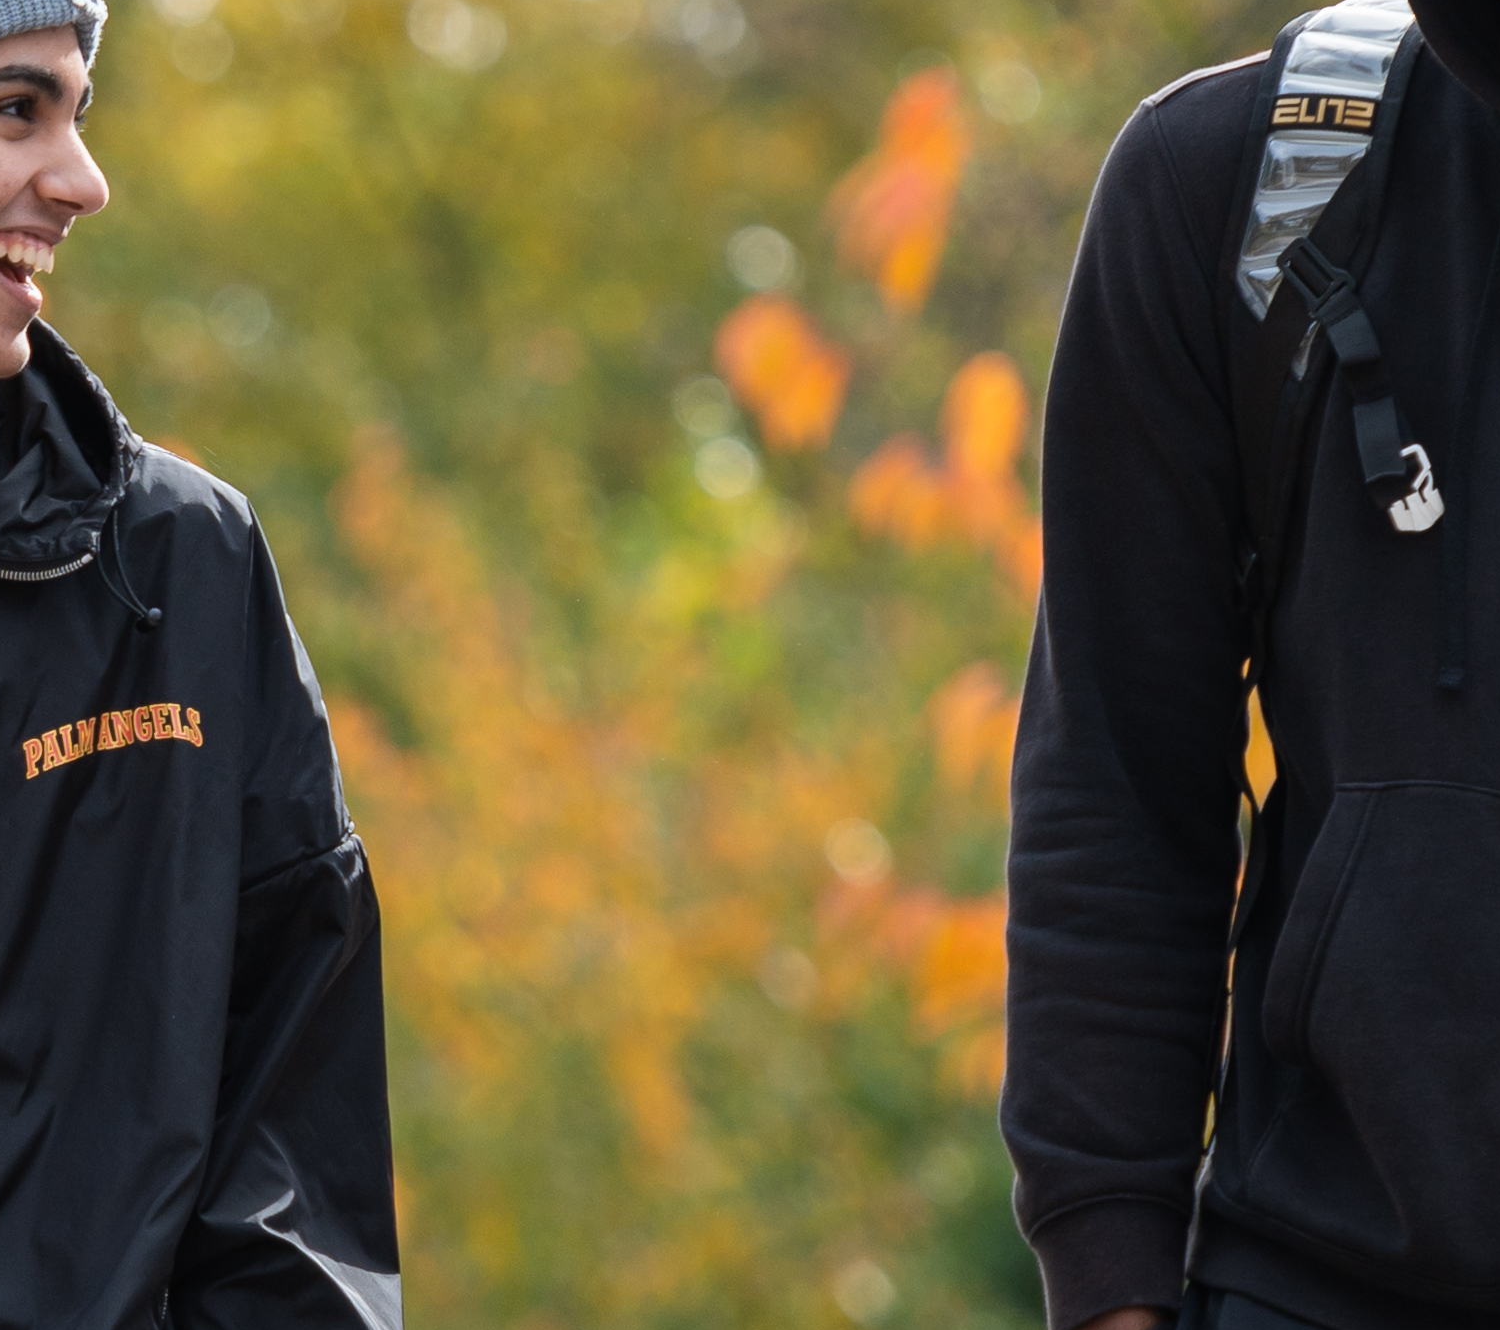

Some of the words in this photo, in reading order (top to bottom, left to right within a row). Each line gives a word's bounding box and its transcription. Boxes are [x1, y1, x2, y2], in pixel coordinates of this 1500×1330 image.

[1272, 97, 1375, 127] ELITE
[23, 717, 97, 780] PALM
[97, 703, 203, 751] ANGELS
